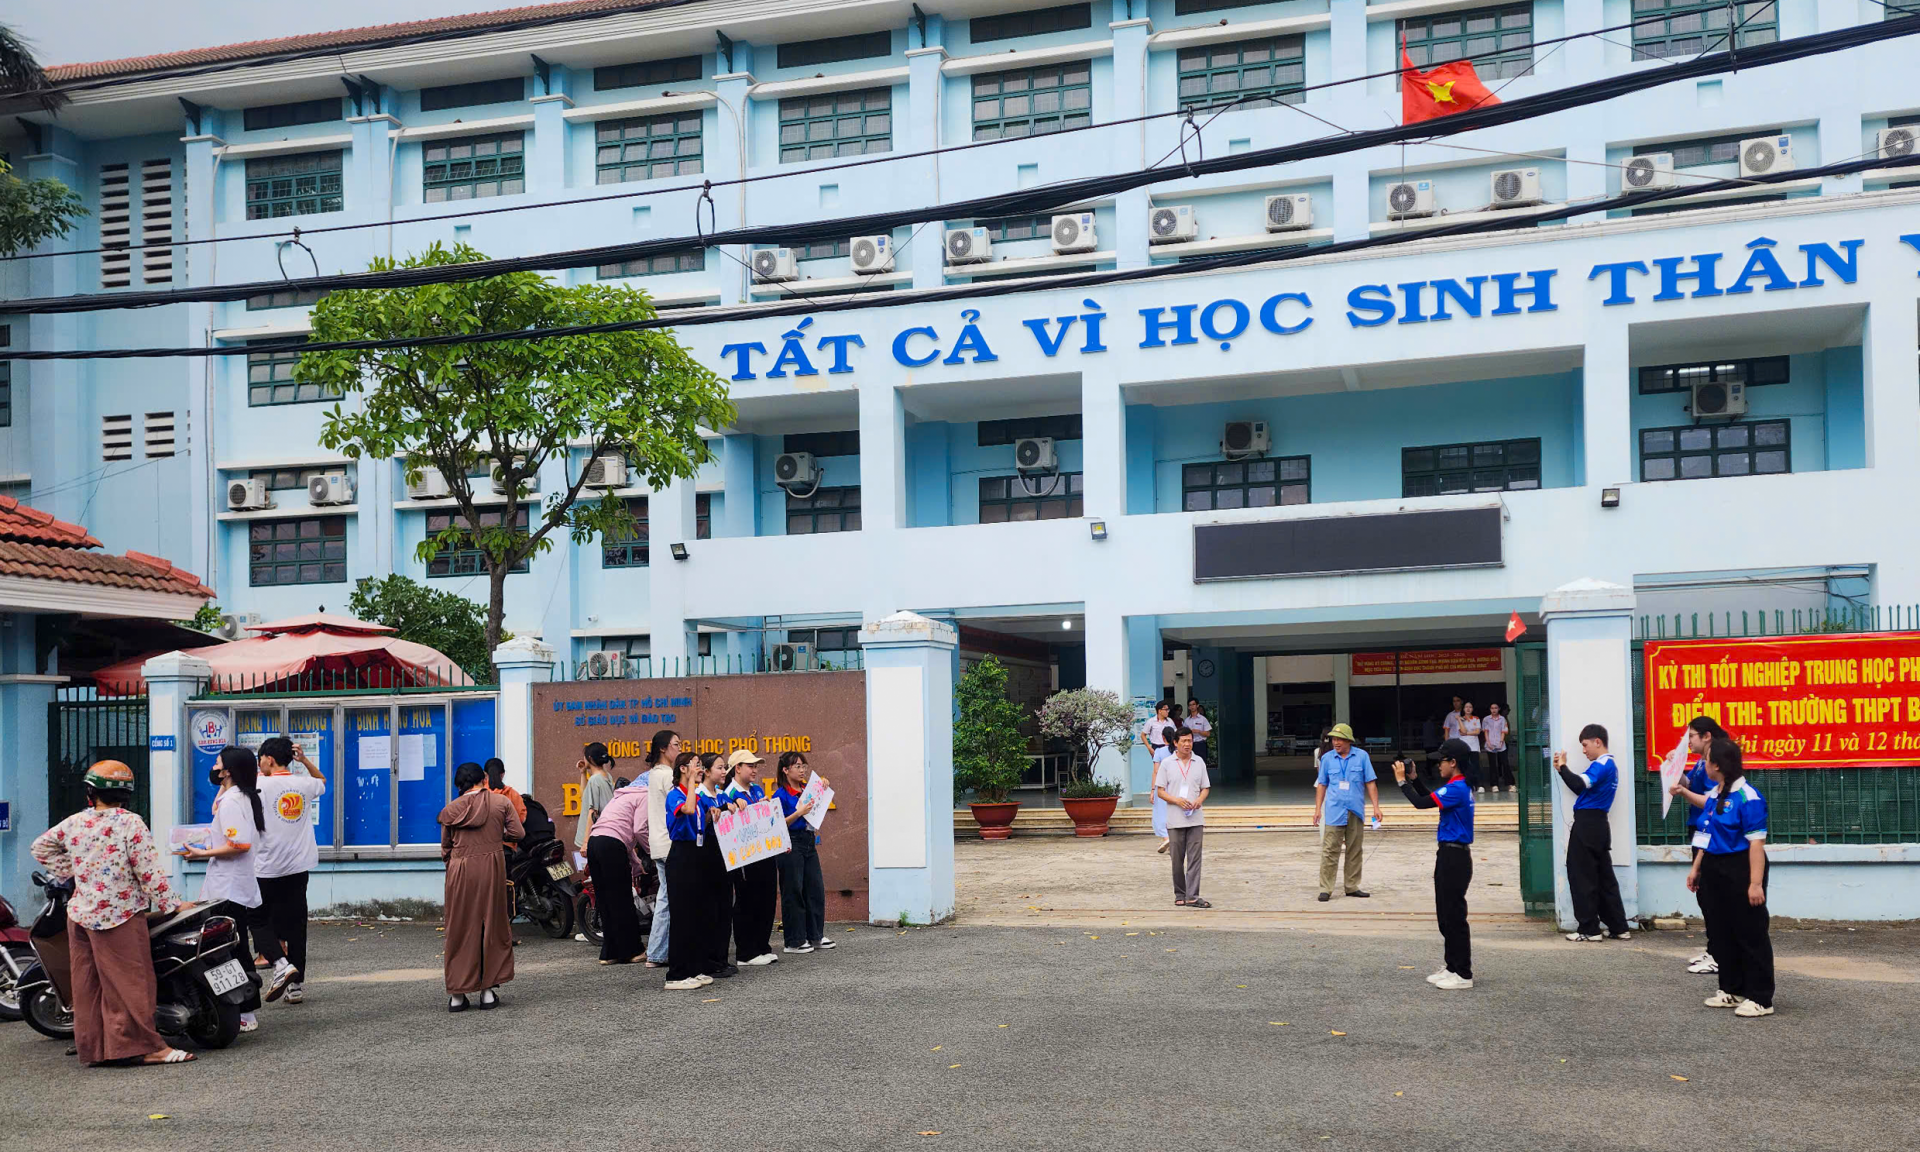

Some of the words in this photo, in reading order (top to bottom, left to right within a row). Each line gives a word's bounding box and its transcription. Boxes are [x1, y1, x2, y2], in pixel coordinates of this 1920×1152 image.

[720, 318, 866, 382] TẤT
[892, 309, 998, 367] CẢ
[1022, 298, 1107, 357] VÌ
[1138, 293, 1313, 352] HỌC
[1346, 269, 1558, 328] SINH
[1588, 237, 1864, 307] THÂN
[1658, 660, 1678, 690] KỲ
[1681, 664, 1706, 689] THI
[1710, 654, 1738, 689] TỐT
[1742, 656, 1801, 692] NGHIỆP
[1804, 659, 1858, 686] TRUNG
[1862, 657, 1895, 689] HỌC
[1726, 701, 1763, 727] THI:
[1768, 693, 1848, 726] TRƯỜNG
[1852, 696, 1902, 724] THPT
[729, 730, 758, 755] PHỔ
[763, 733, 812, 754] THÔNG
[1762, 734, 1806, 757] ngày
[1811, 733, 1833, 752] 11
[1839, 732, 1860, 751] và
[1866, 731, 1888, 751] 12
[210, 963, 236, 981] 59-G1
[213, 972, 246, 993] 911.28
